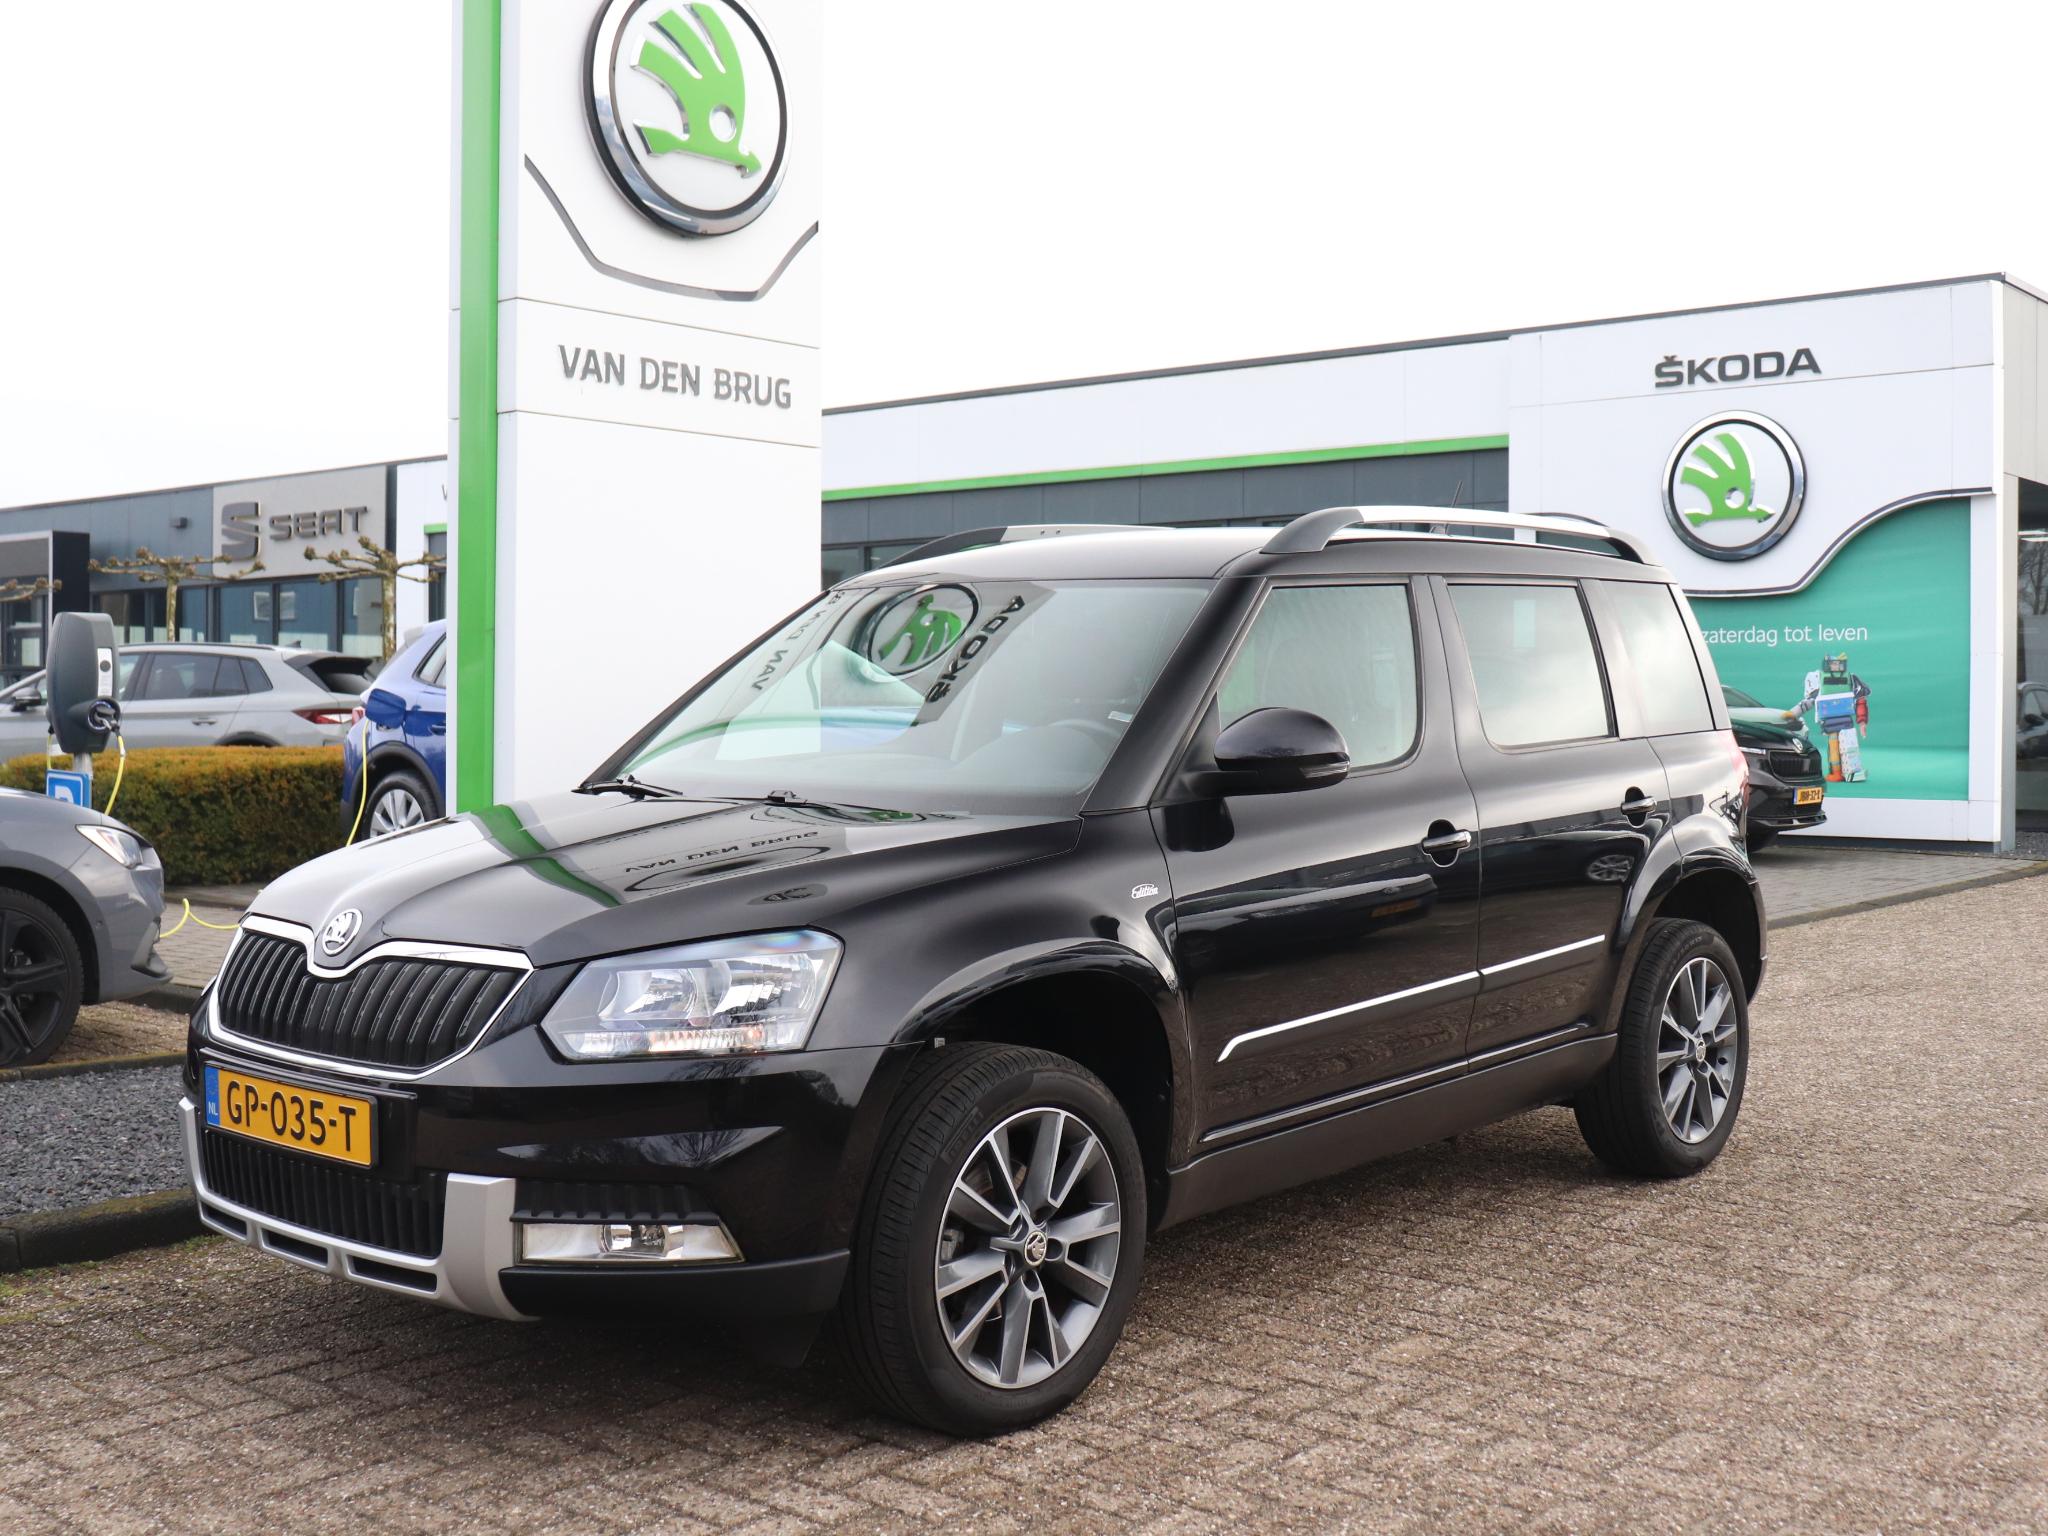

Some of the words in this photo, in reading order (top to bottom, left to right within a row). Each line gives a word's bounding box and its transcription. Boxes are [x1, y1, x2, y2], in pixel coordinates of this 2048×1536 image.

[558, 345, 625, 386] VAN
[640, 357, 700, 397] DEN
[714, 368, 791, 409] BRUG
[1655, 348, 1821, 388] ŠKODA
[269, 506, 368, 542] SEAT
[1703, 625, 1777, 647] zaterdag
[1784, 626, 1812, 642] tot
[1819, 624, 1868, 641] leven
[208, 1101, 218, 1116] NL
[227, 1080, 357, 1152] GP-035-T
